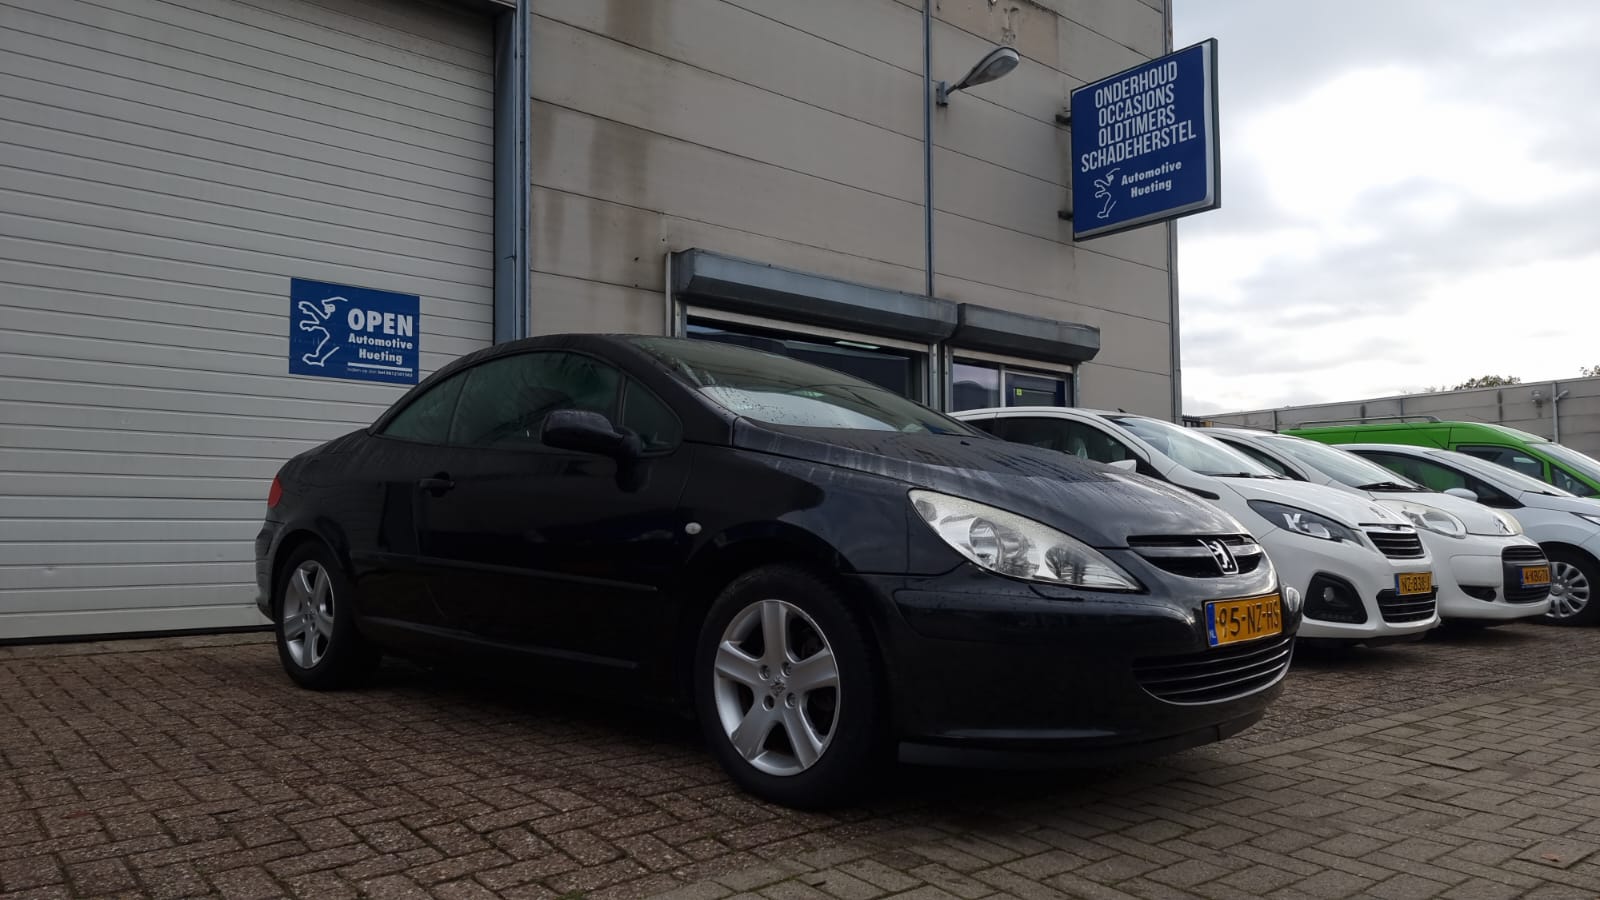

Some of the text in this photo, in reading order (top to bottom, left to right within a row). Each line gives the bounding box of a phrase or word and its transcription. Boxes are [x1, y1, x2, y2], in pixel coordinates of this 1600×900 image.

[1095, 61, 1178, 108] ONDERHOUD
[1098, 84, 1175, 127] OCCASIONS
[1098, 105, 1176, 147] OLDTIMERS
[1081, 120, 1197, 173] SCHADEHERSTEL
[1121, 161, 1182, 186] Automotive
[1130, 180, 1172, 198] Hueting
[347, 308, 413, 337] OPEN
[348, 333, 413, 349] Automotive
[359, 348, 403, 365] Hueting
[1219, 600, 1280, 638] 95-NZ-HS
